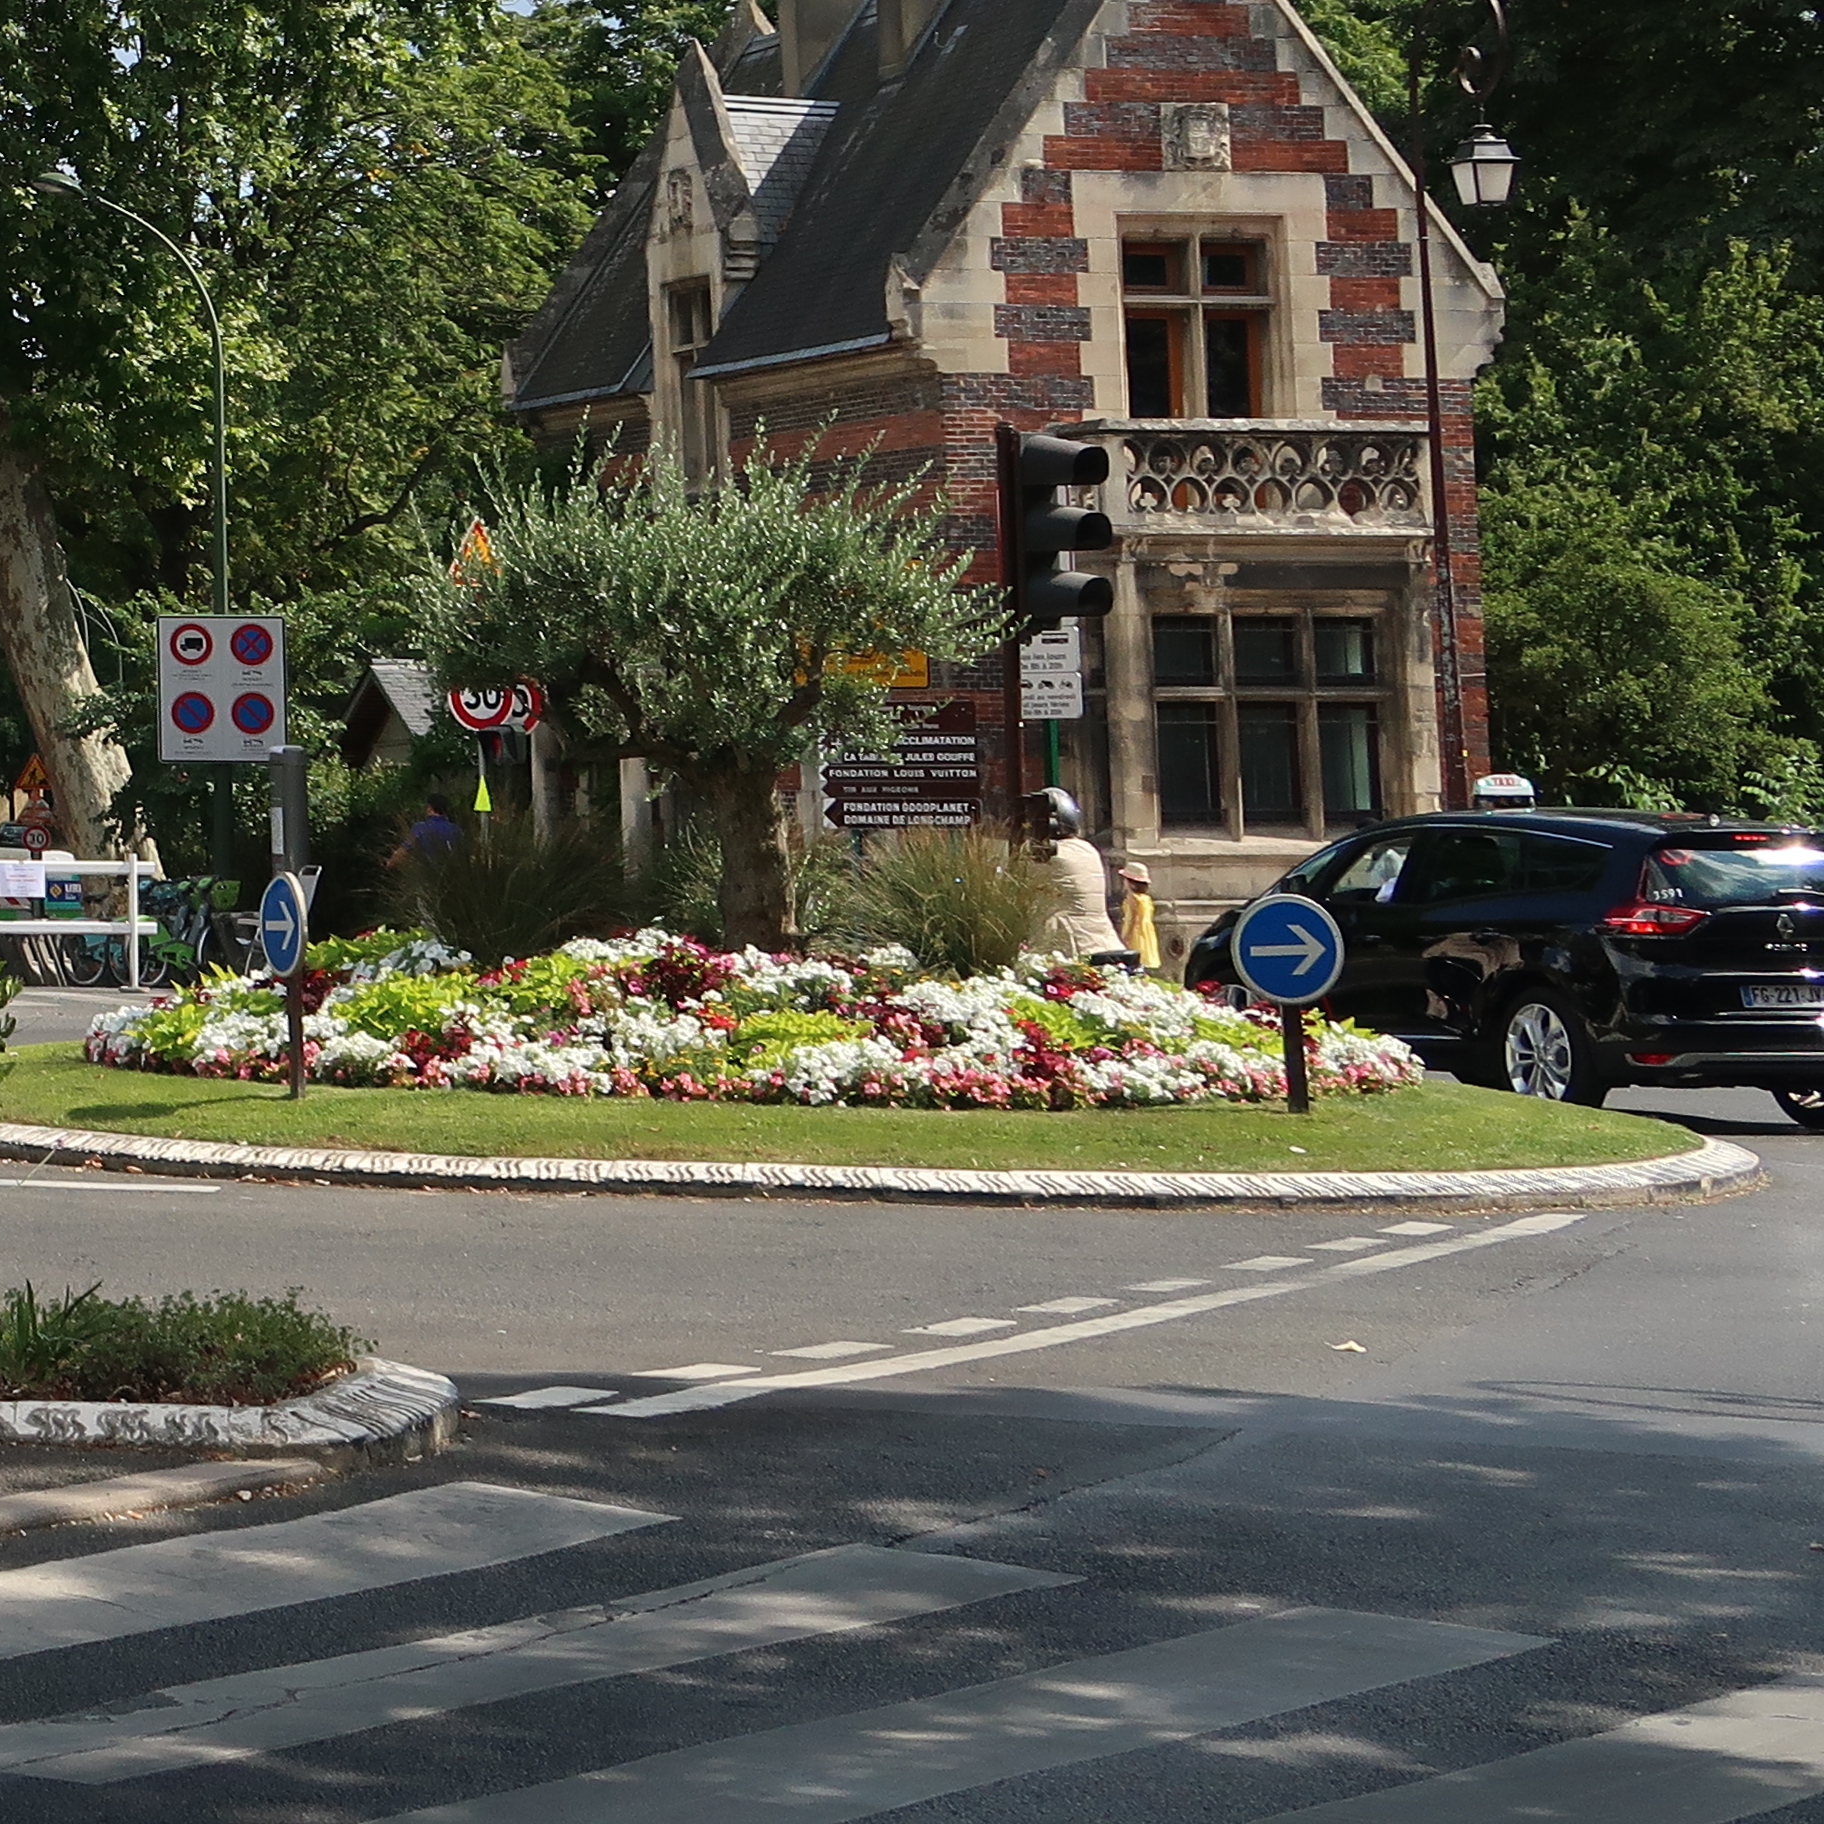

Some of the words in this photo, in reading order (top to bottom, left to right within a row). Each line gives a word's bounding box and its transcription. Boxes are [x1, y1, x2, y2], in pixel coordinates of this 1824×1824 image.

[844, 752, 857, 762] LA
[905, 752, 935, 762] JULES
[828, 769, 889, 778] FONDATION
[893, 769, 925, 778] LOUIS
[929, 769, 977, 778] VUITTON
[843, 802, 900, 812] FONDATION
[901, 802, 969, 813] GOODPLANET
[843, 814, 890, 825] DOMAINE
[892, 814, 906, 825] DE
[907, 814, 971, 825] LONGCHAMP
[28, 833, 45, 845] 30
[1652, 887, 1683, 901] 3591
